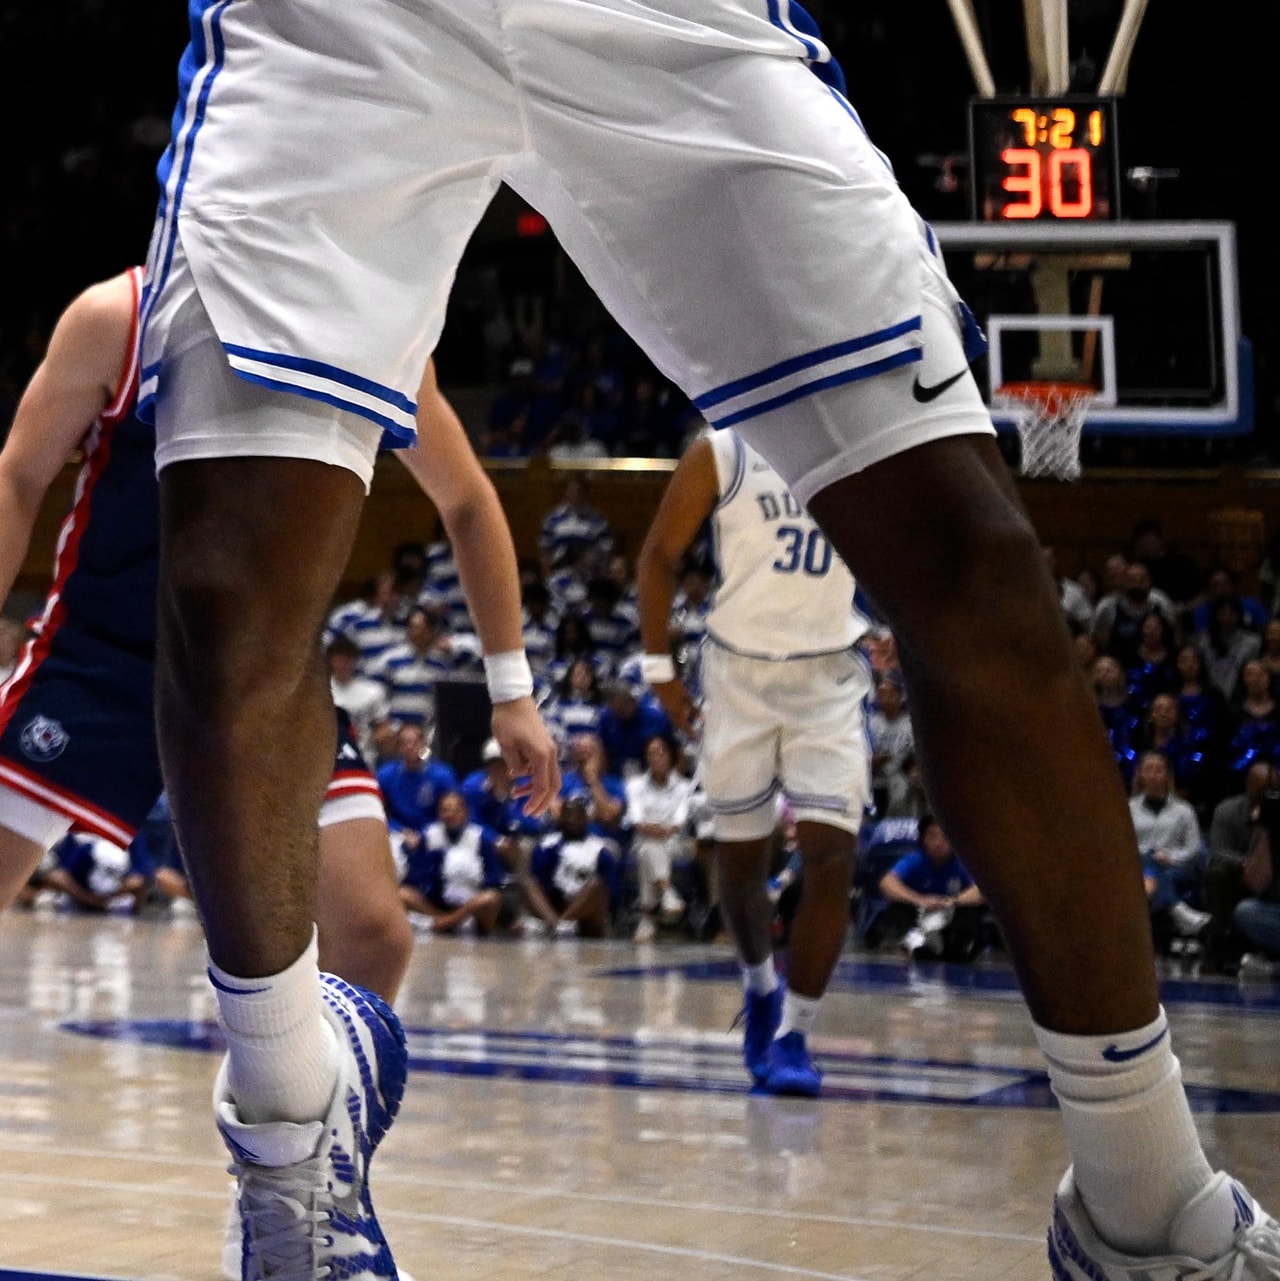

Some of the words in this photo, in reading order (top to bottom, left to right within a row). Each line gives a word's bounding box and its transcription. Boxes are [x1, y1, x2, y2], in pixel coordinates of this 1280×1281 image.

[1011, 107, 1103, 150] 7:21
[1000, 147, 1092, 219] 30
[757, 490, 802, 521] DU
[773, 525, 833, 578] 30
